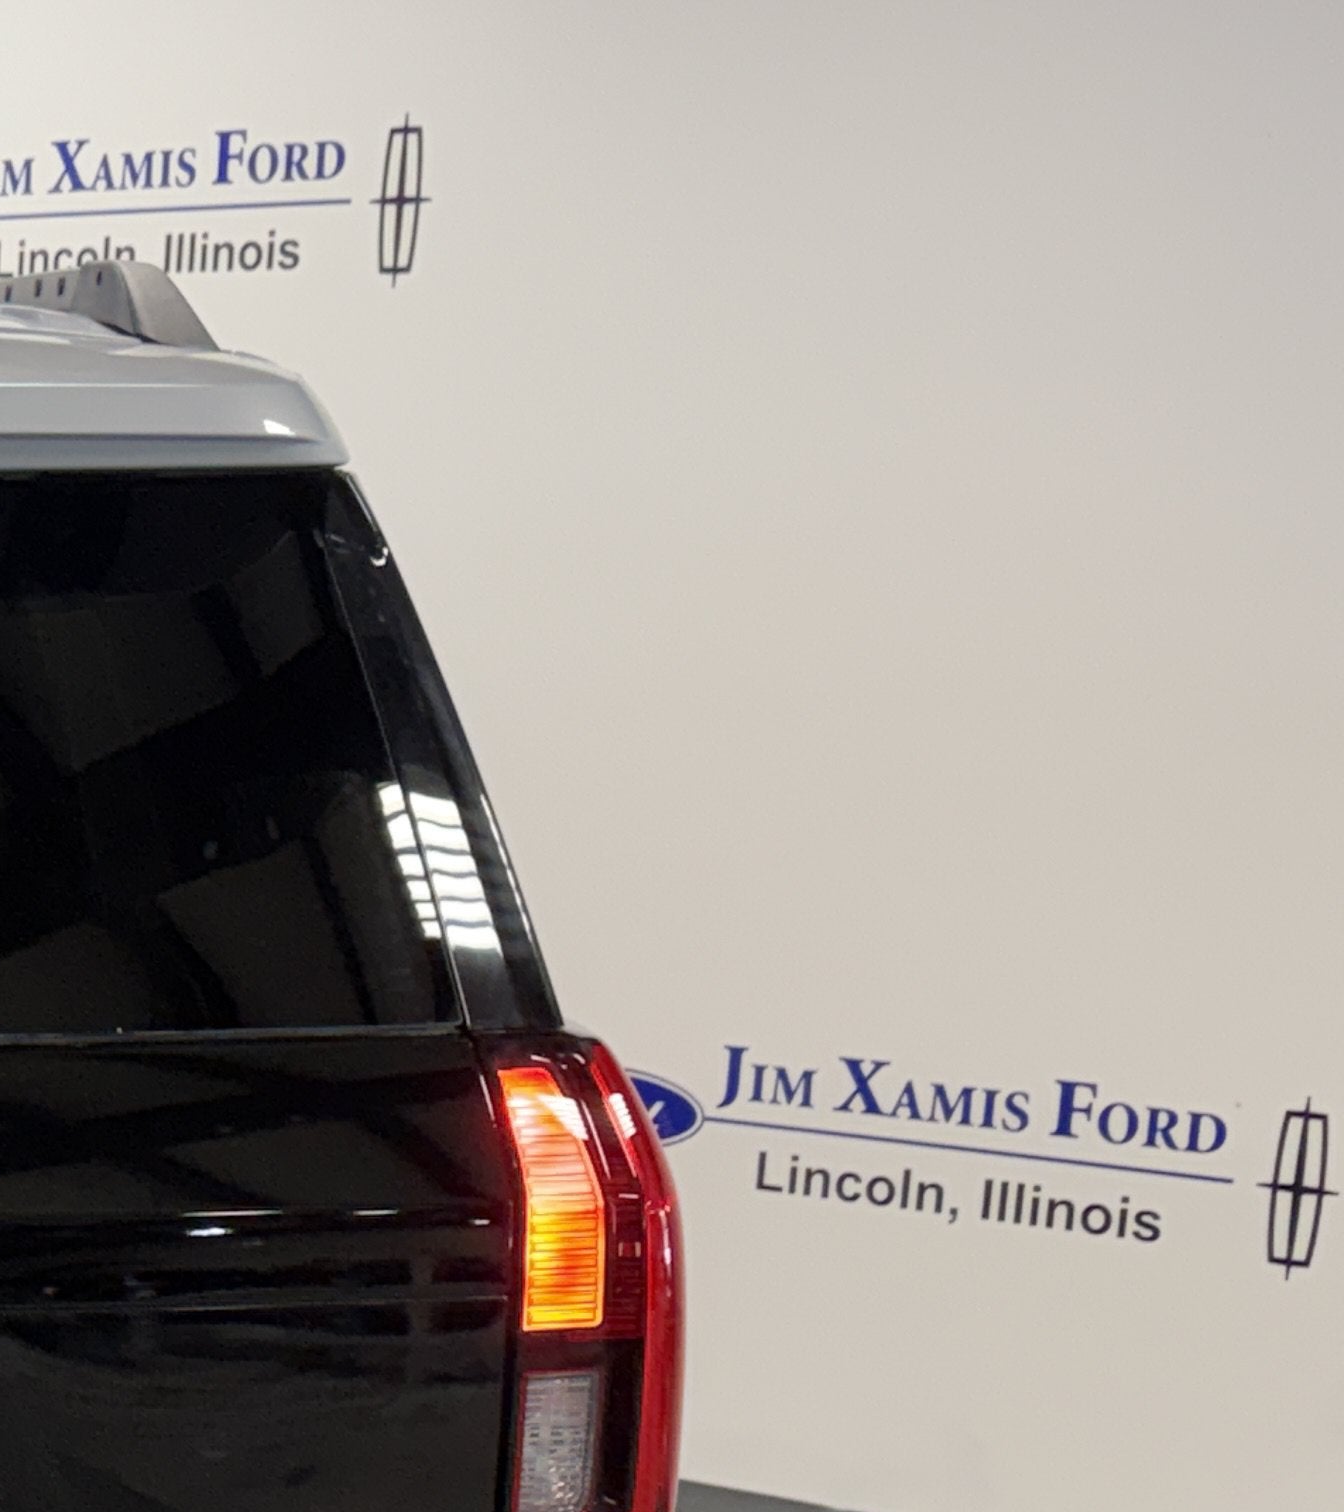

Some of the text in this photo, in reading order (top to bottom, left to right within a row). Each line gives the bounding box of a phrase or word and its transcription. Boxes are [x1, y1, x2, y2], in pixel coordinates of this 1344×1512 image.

[48, 139, 196, 195] XAMIS
[213, 129, 346, 187] FORD
[165, 230, 300, 273] Illinois
[716, 1045, 1228, 1156] JIM XAMIS FORD
[755, 1151, 1163, 1244] Lincoln, Illinois
